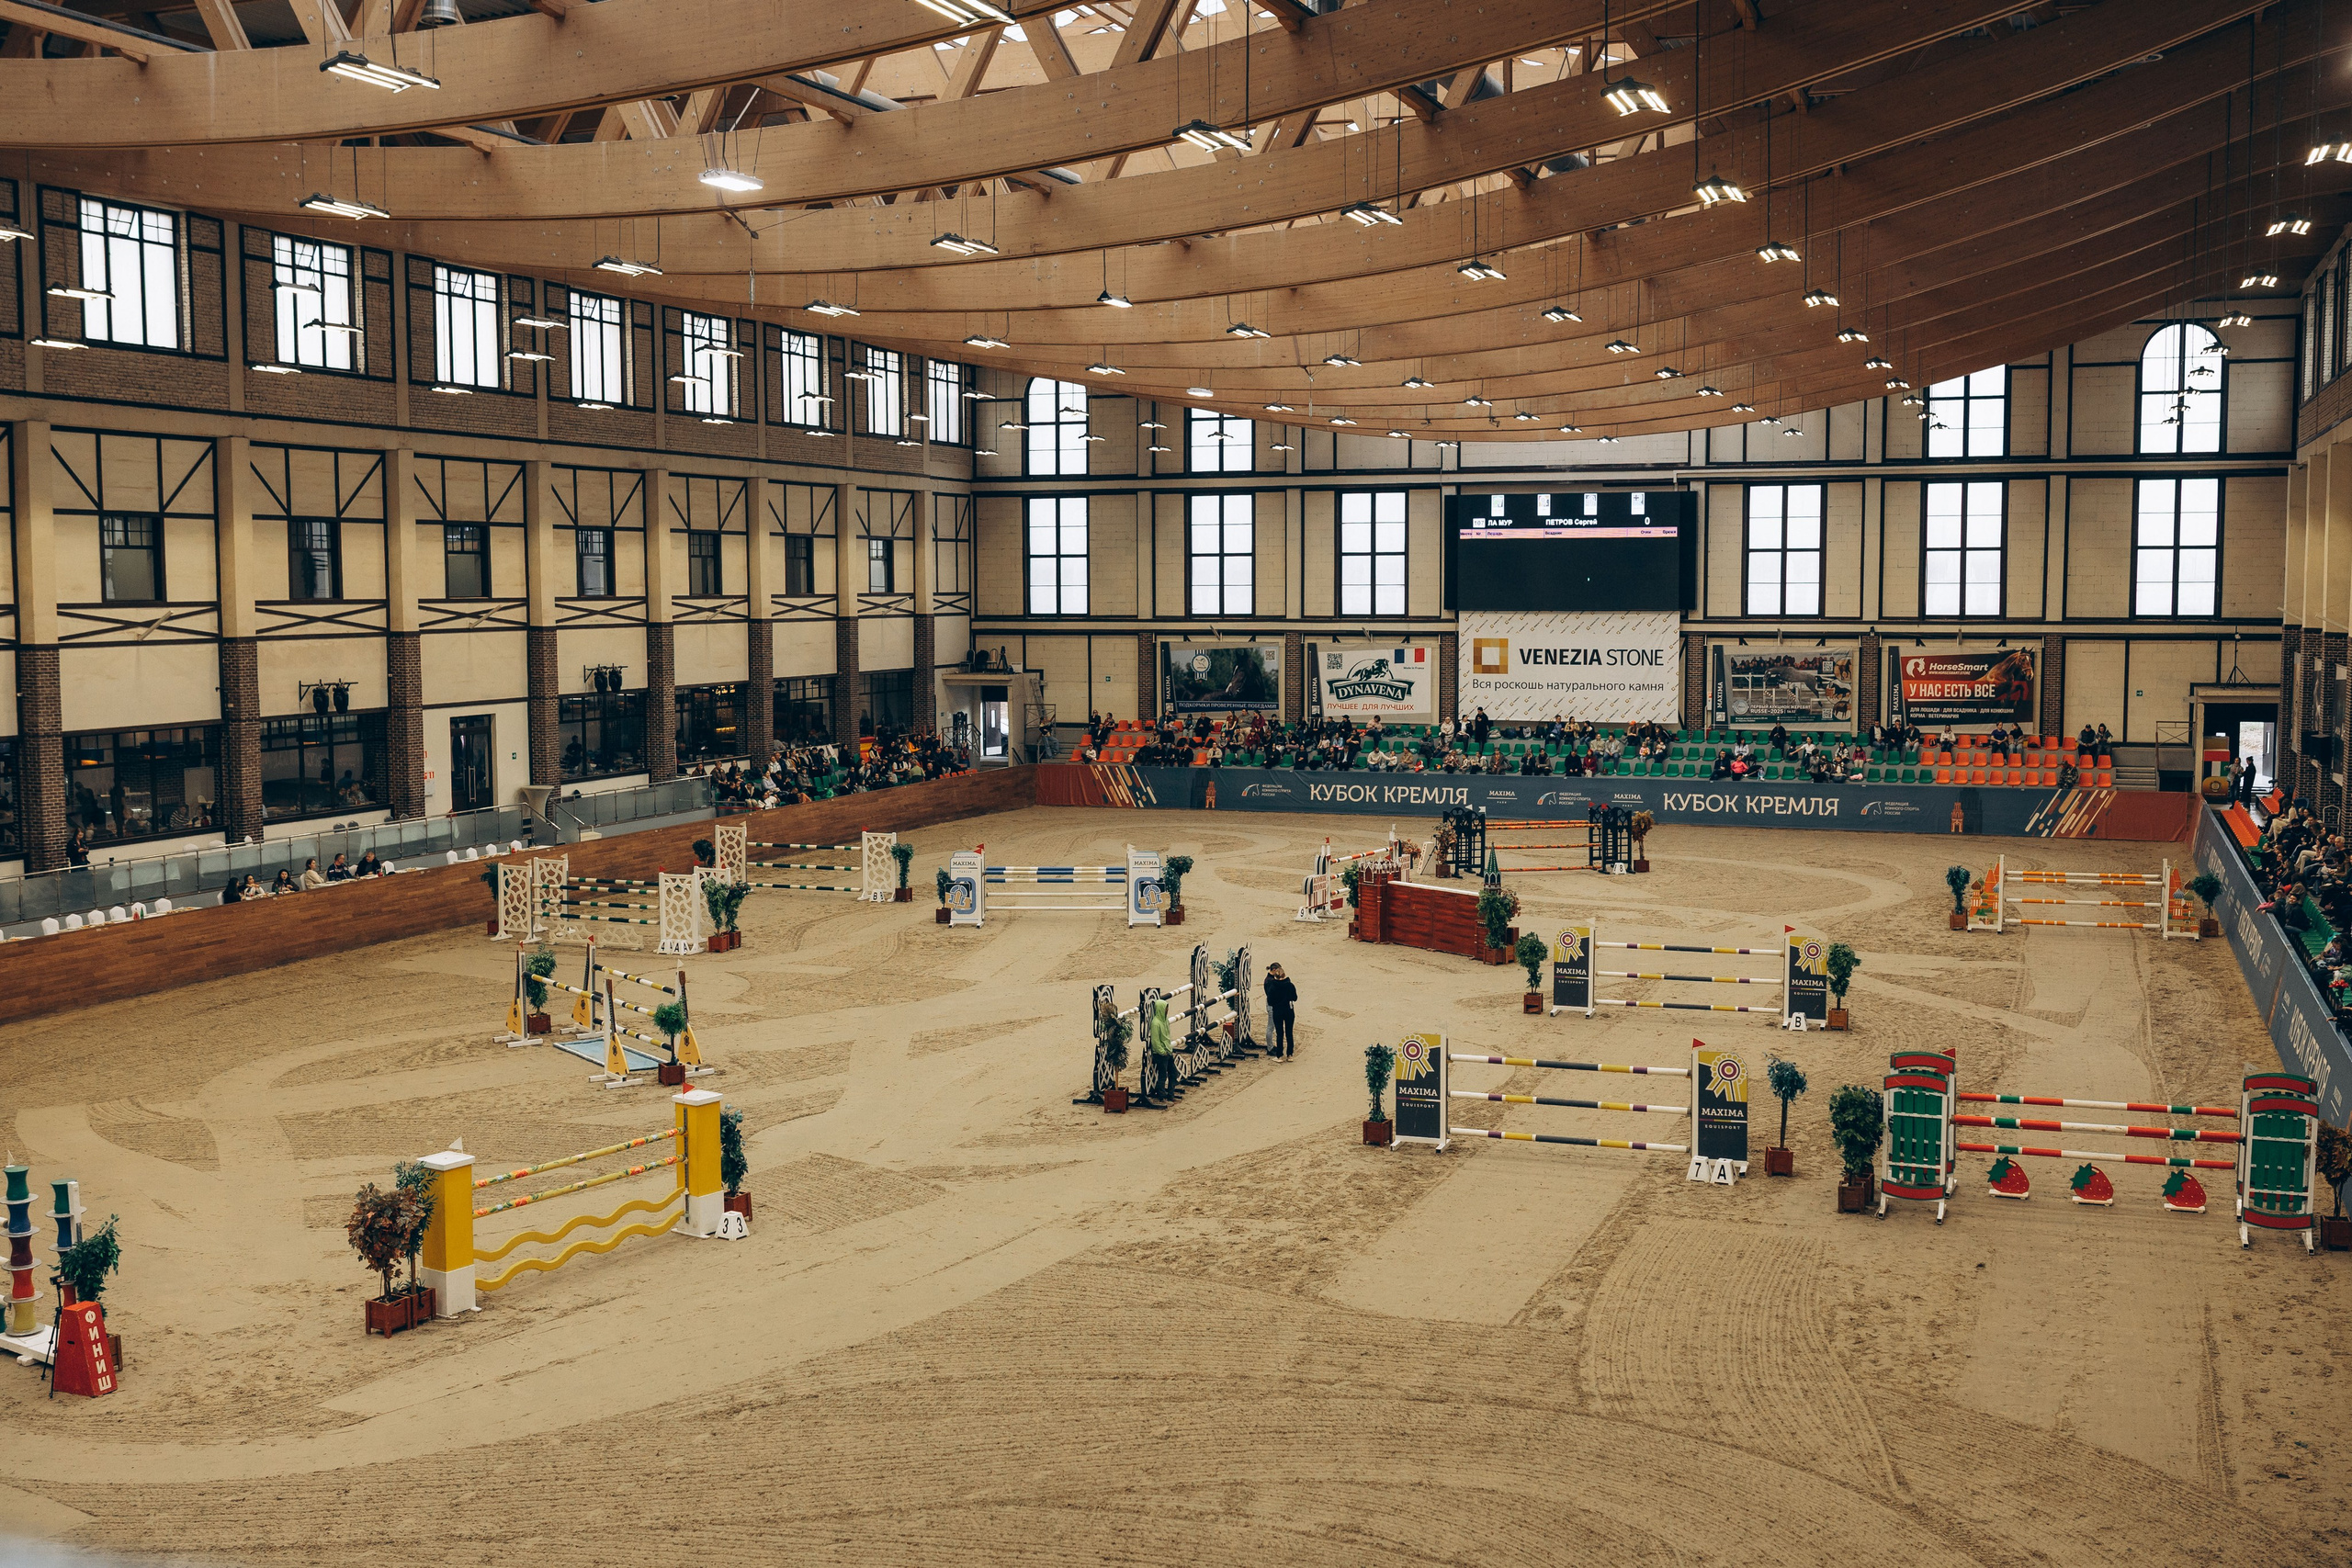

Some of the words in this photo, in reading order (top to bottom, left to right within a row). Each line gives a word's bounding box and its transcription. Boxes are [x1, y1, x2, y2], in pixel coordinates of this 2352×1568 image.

[1574, 518, 1598, 526] Сергей
[1520, 649, 1602, 665] VENEZIA
[1606, 649, 1664, 666] STONE
[1929, 662, 1989, 671] HorseSmart
[1338, 684, 1403, 699] DYNAVENA
[1473, 679, 1491, 689] Вся
[1495, 681, 1544, 691] роскошь
[1547, 682, 1625, 693] натурального
[1629, 683, 1664, 692] камня
[1909, 683, 1917, 697] У
[1919, 683, 1941, 697] НАС
[1944, 683, 1972, 697] ЕСТЬ
[1974, 683, 1996, 697] ВСЕ
[1362, 703, 1378, 711] ДЛЯ
[1310, 784, 1377, 802] КУБОК
[1384, 785, 1468, 805] КРЕМЛЯ
[1664, 793, 1739, 813] КУБОК
[1746, 795, 1839, 816] КРЕМЛЯ
[1301, 908, 1305, 917] 9
[662, 942, 665, 951] 4
[673, 942, 679, 952] A
[1556, 967, 1587, 976] MAXIMA
[1795, 1017, 1801, 1027] B
[1398, 1087, 1438, 1097] MAXIMA
[1702, 1108, 1744, 1117] MAXIMA
[1695, 1162, 1702, 1178] 7
[1717, 1164, 1726, 1179] A
[722, 1217, 729, 1234] 3
[736, 1216, 743, 1233] 3
[85, 1310, 112, 1392] ФИНИШ
